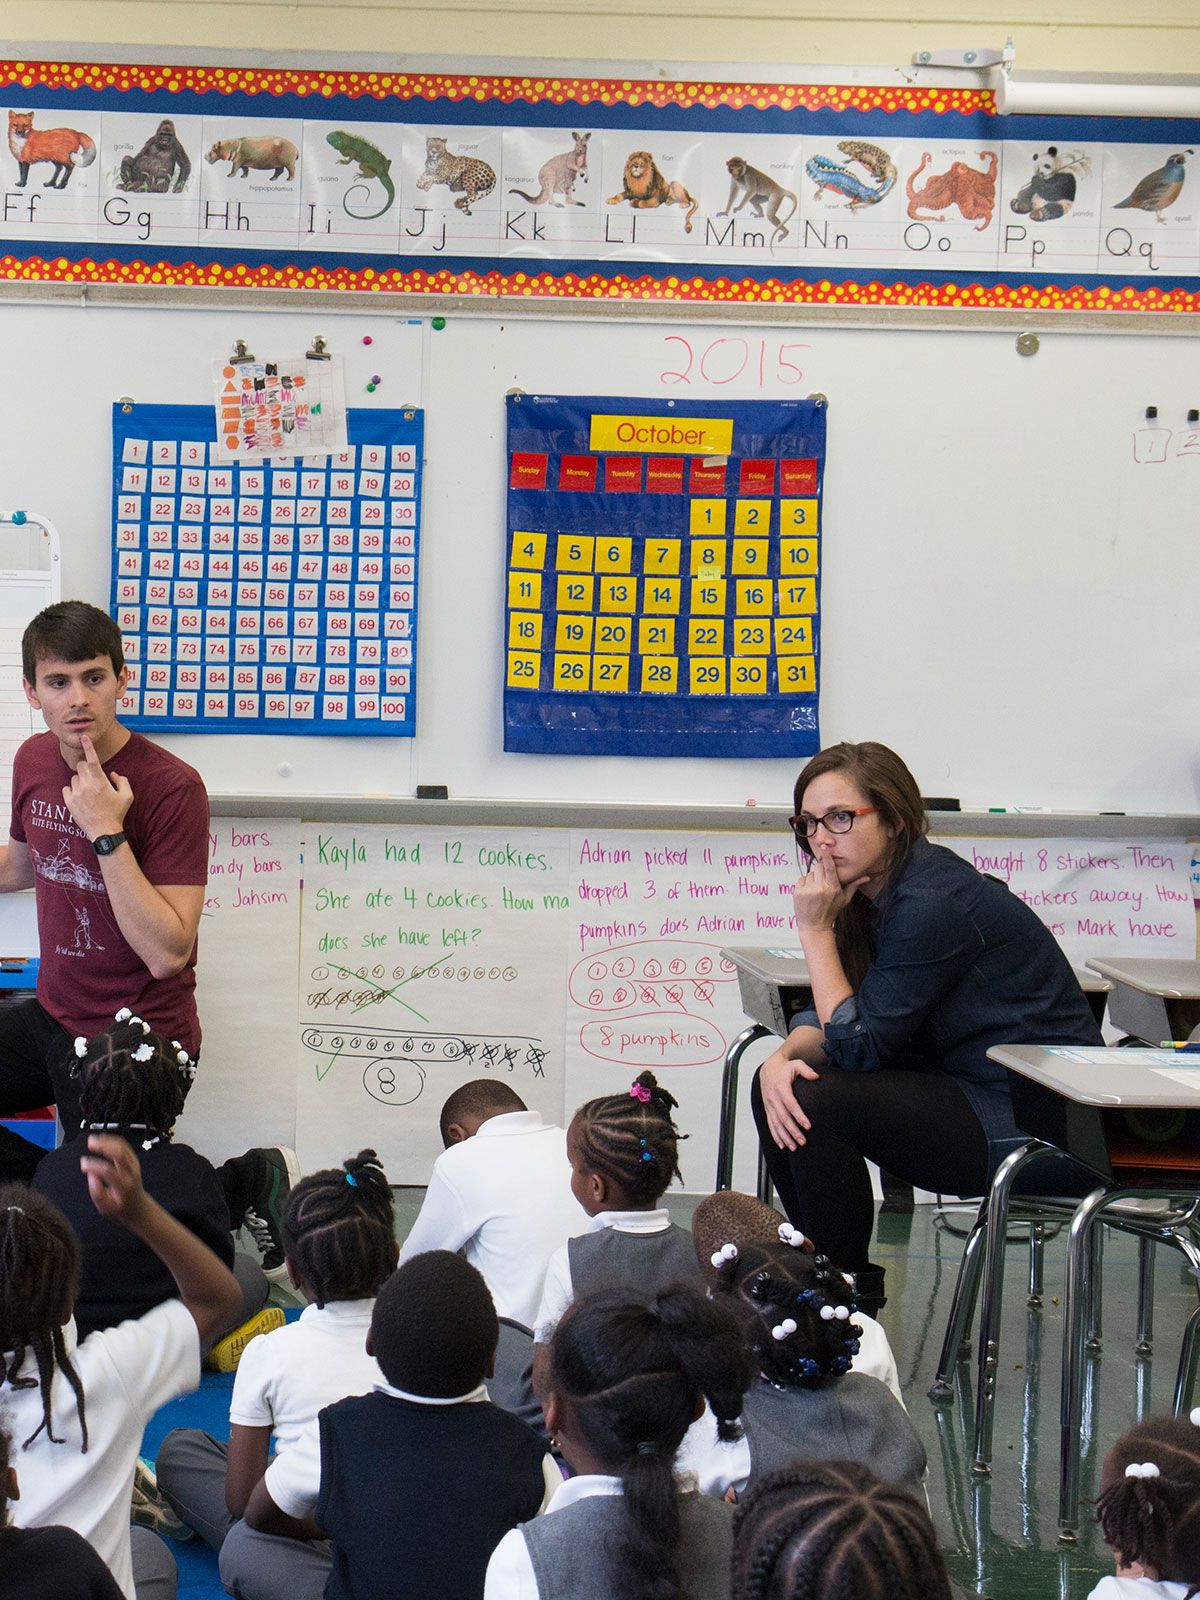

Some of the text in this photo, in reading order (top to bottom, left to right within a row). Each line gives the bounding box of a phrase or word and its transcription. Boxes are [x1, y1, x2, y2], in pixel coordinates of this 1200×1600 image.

[113, 142, 134, 151] gorilla
[249, 183, 293, 193] hippopotamus
[504, 175, 534, 184] kangaroo
[4, 193, 41, 221] Ff
[103, 196, 152, 240] Gg
[205, 200, 249, 230] Hh
[307, 204, 331, 233] Ii
[406, 208, 446, 251] Jj
[506, 211, 546, 240] Kk
[606, 214, 635, 243] Ll
[706, 217, 765, 246] Mm
[805, 221, 848, 249] Nn
[904, 223, 951, 251] Oo
[1005, 225, 1045, 267] Pp
[1106, 228, 1159, 270] Qq
[660, 336, 810, 387] 2015
[615, 420, 708, 447] October
[131, 475, 410, 490] 11 12 13 14 15 16 17 18 19 20
[518, 466, 812, 481] Sunday Monday Tuesday Wednesday Thursday Friday Saturday
[705, 508, 805, 524] 1 2 3
[523, 542, 809, 564] 4 5 6 7 8 9 10
[123, 586, 409, 601] 51 52 53 54 55 56 57 58 59 60
[520, 582, 806, 604] 11 12 13 14 15 16 17
[32, 818, 75, 834] KITE FLYING
[231, 828, 272, 848] bars.
[318, 835, 552, 872] Kayla had 12 cookies.
[579, 839, 631, 865] Adrian
[645, 848, 688, 872] picked
[703, 849, 712, 865] 11
[725, 852, 793, 874] pumpkins.
[973, 846, 1175, 882] bought 8 stickers. Then
[209, 854, 286, 881] andy bars.
[232, 887, 288, 909] Jahsim
[315, 888, 351, 911] She
[365, 889, 393, 908] ate
[404, 887, 416, 908] 4
[502, 887, 533, 910] How
[578, 879, 628, 907] dropped
[644, 880, 656, 899] 3
[667, 882, 681, 899] of
[688, 881, 728, 899] them.
[738, 877, 769, 896] How
[1155, 884, 1188, 902] How
[579, 920, 647, 952] pumpkins
[660, 917, 689, 936] does
[697, 915, 745, 932] Adrian
[756, 912, 785, 929] have
[1077, 918, 1118, 937] Mark
[1129, 918, 1177, 937] have
[318, 928, 482, 951] does she have left?
[599, 1025, 710, 1055] 8 pumpkins
[377, 1066, 396, 1094] 8
